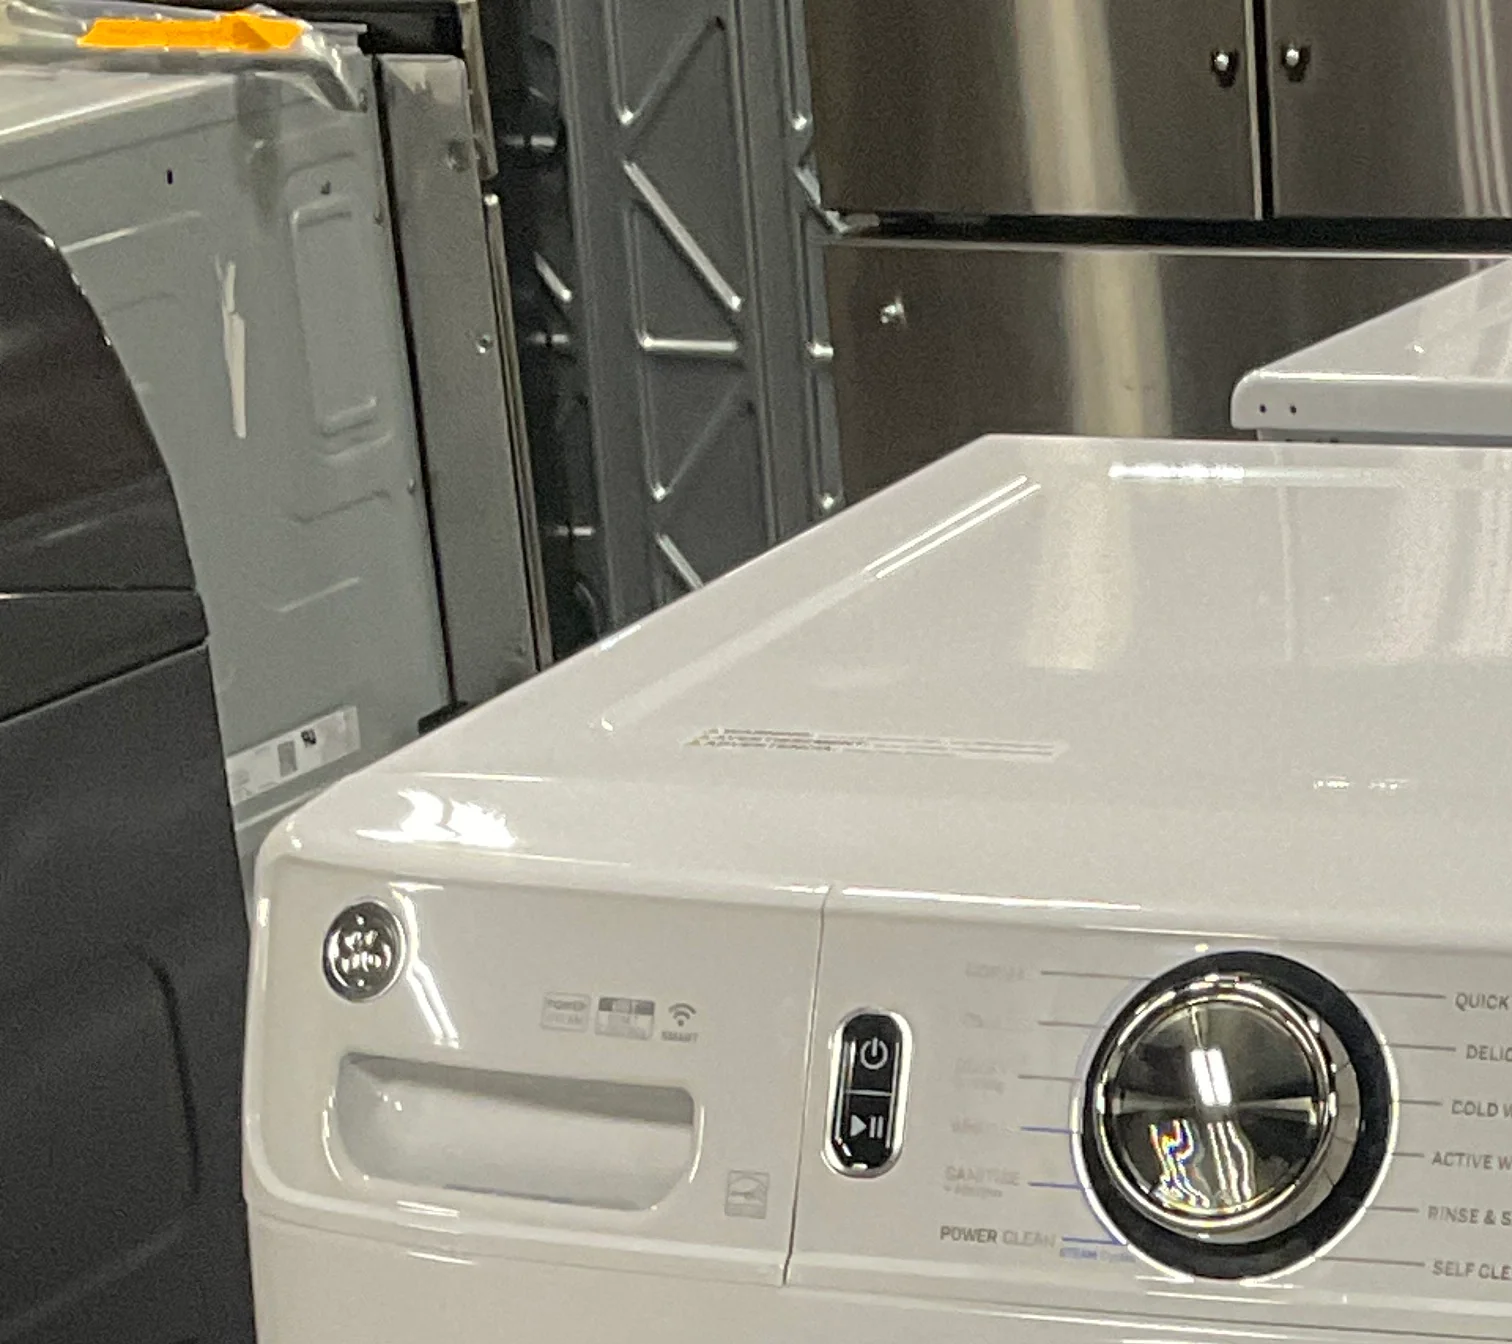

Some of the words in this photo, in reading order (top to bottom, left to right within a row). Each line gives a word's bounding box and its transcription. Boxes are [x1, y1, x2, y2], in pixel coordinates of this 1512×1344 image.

[1455, 991, 1510, 1012] QUICK
[1451, 1099, 1499, 1118] COLD
[1432, 1151, 1494, 1171] ACTIVE
[1427, 1205, 1480, 1225] RINSE
[1483, 1209, 1497, 1226] &
[939, 1225, 998, 1245] POWER
[1432, 1259, 1476, 1278] SELF
